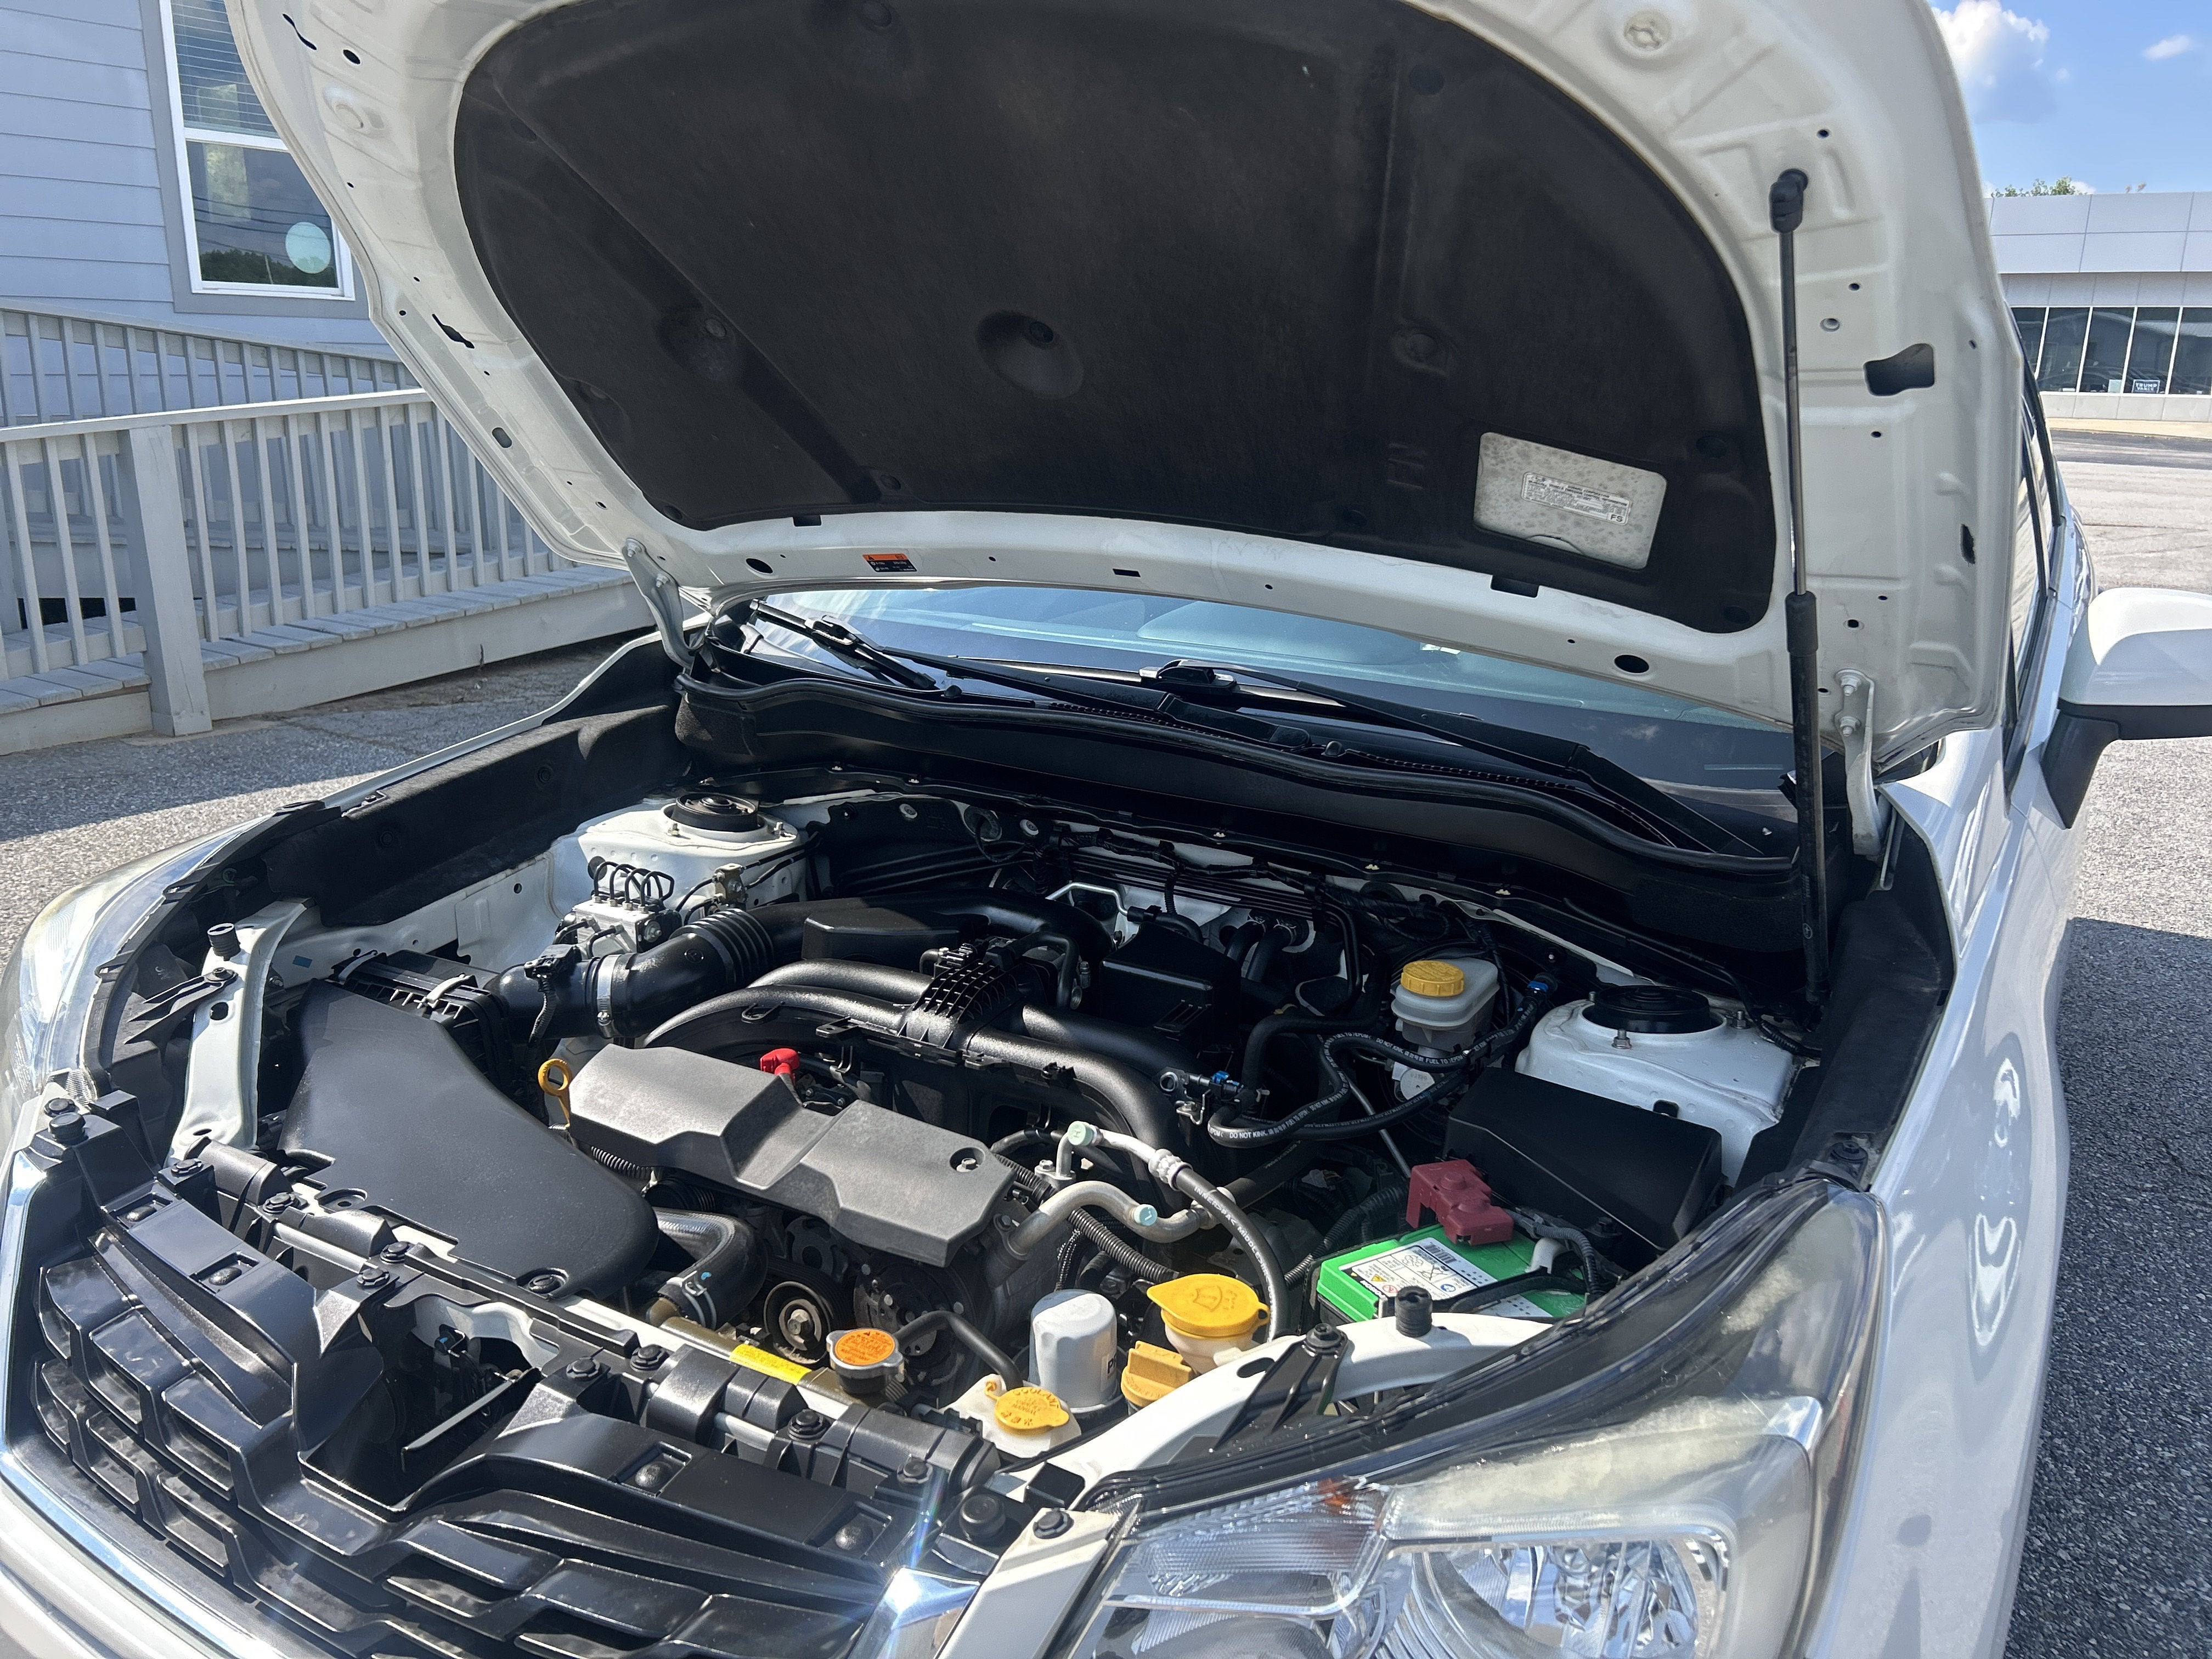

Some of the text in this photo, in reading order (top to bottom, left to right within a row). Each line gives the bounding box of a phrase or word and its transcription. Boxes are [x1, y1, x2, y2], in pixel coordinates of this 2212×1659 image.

[1610, 514, 1623, 523] FS
[1194, 1186, 1237, 1226] INNER>PA<
[1013, 1387, 1059, 1408] COOLANT
